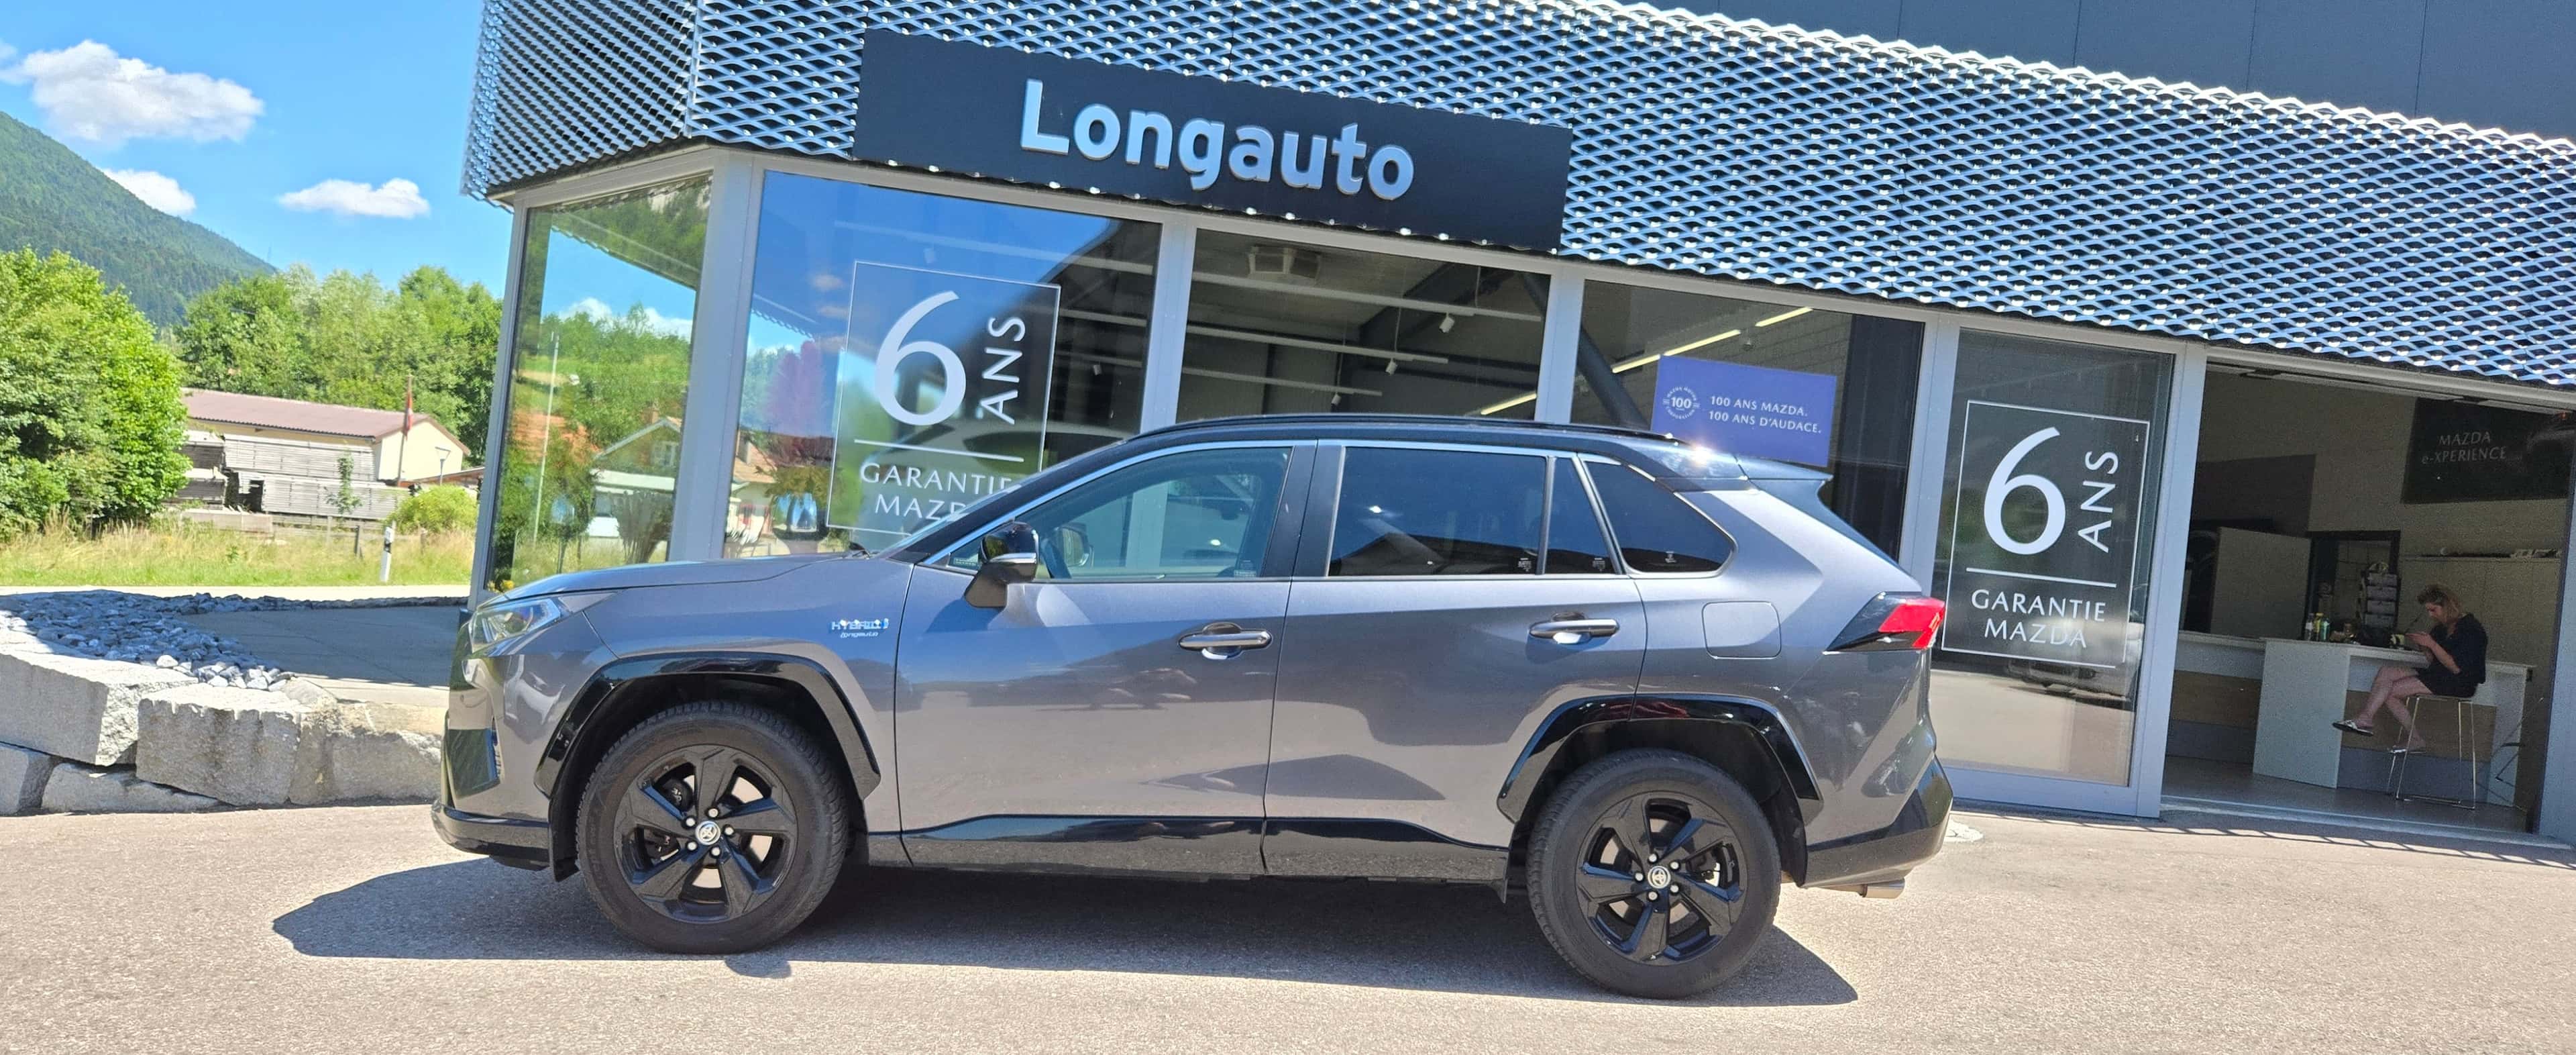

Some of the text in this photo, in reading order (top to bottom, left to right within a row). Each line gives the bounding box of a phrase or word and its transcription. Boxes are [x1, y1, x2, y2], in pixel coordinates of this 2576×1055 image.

[1020, 79, 1414, 201] Longauto
[875, 291, 966, 426] 6
[980, 317, 1026, 425] ANS
[1670, 397, 1692, 409] 100
[1709, 410, 1729, 421] 100
[1732, 414, 1756, 425] ANS
[1711, 395, 1808, 417] 100 ANS MAZDA.
[2438, 431, 2491, 446] MAZDA
[2422, 446, 2507, 464] e-XPERIENCE
[1984, 426, 2066, 555] 6
[2078, 450, 2119, 554] ANS
[875, 493, 967, 521] MAZ
[1971, 589, 2106, 623] GARANTIE
[1984, 618, 2087, 648] MAZDA
